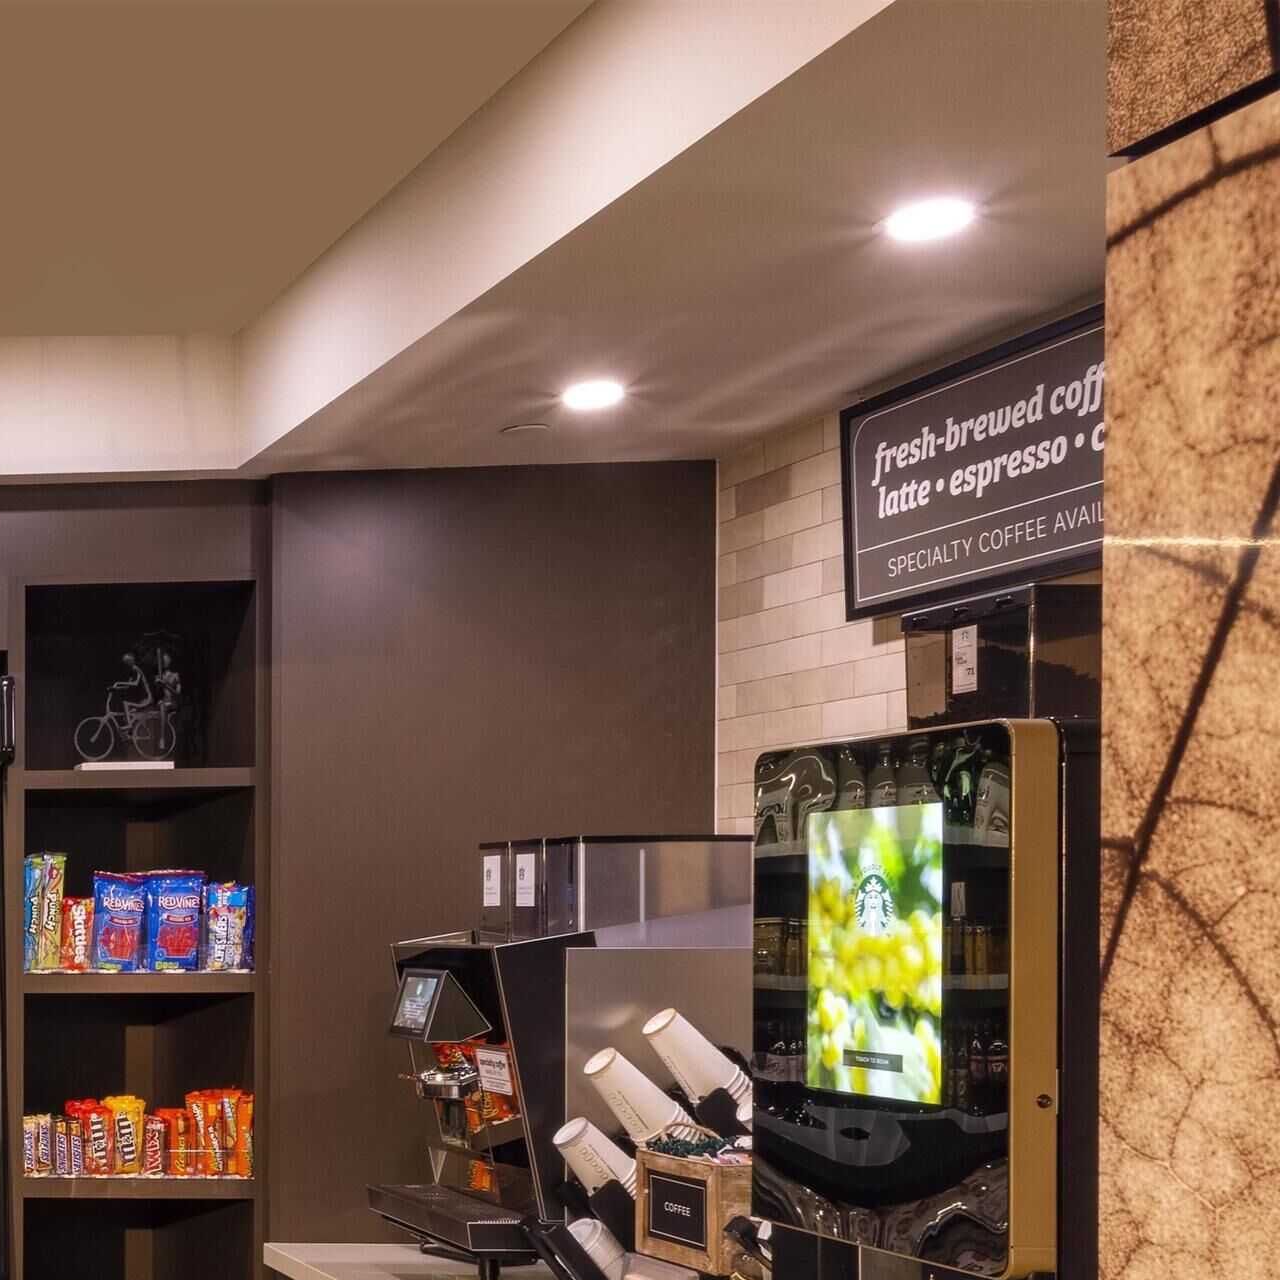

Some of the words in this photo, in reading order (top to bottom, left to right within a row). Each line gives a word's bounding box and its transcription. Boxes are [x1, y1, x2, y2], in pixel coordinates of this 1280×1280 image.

[872, 384, 1045, 487] fresh-brewed
[878, 478, 930, 519] latte
[949, 435, 1068, 498] espresso
[888, 536, 973, 577] SPECIALTY
[978, 516, 1047, 553] COFFEE
[71, 904, 86, 965] Skittles
[664, 1201, 691, 1217] COFFEE
